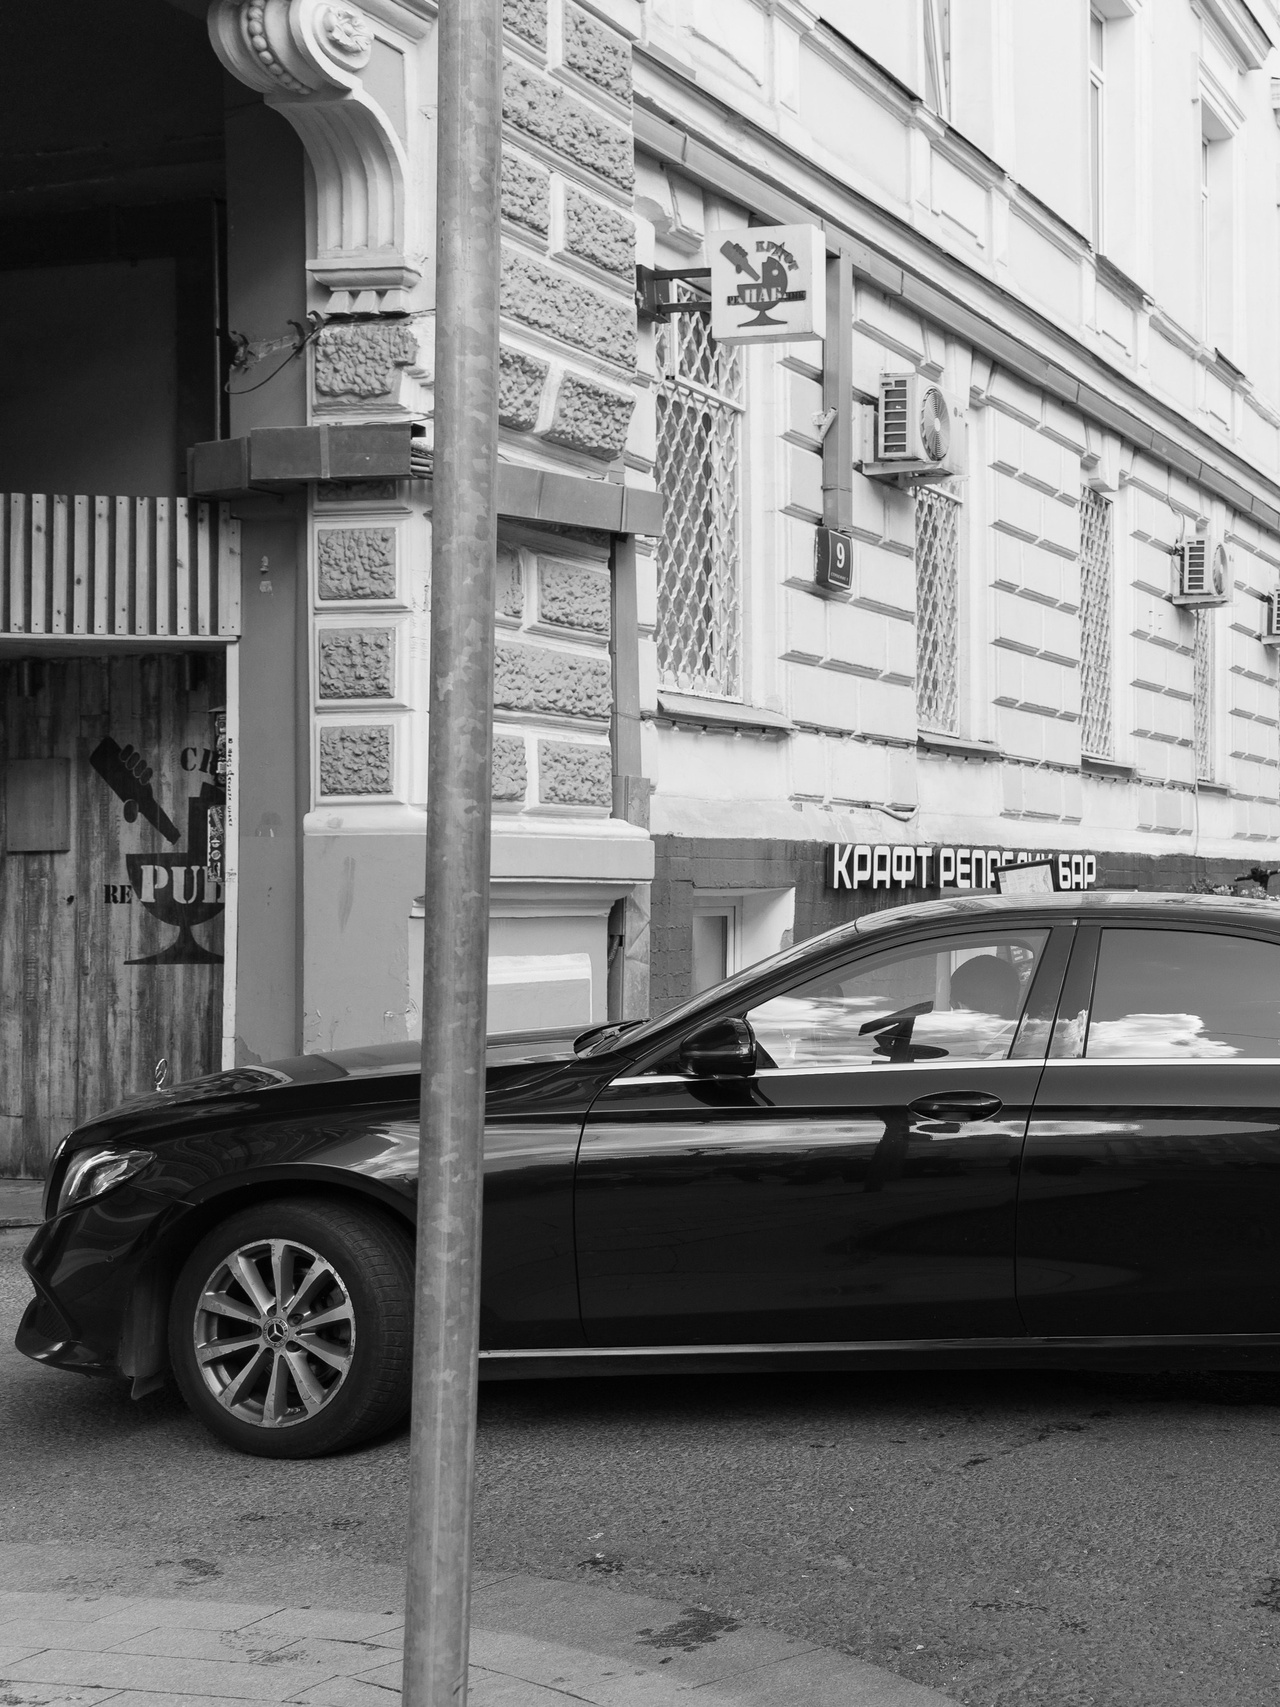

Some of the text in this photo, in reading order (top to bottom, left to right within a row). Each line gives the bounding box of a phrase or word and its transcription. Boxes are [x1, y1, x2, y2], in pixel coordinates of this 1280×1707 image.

[837, 542, 845, 569] 9
[834, 843, 932, 889] КРАФТ
[1058, 853, 1097, 889] БАР
